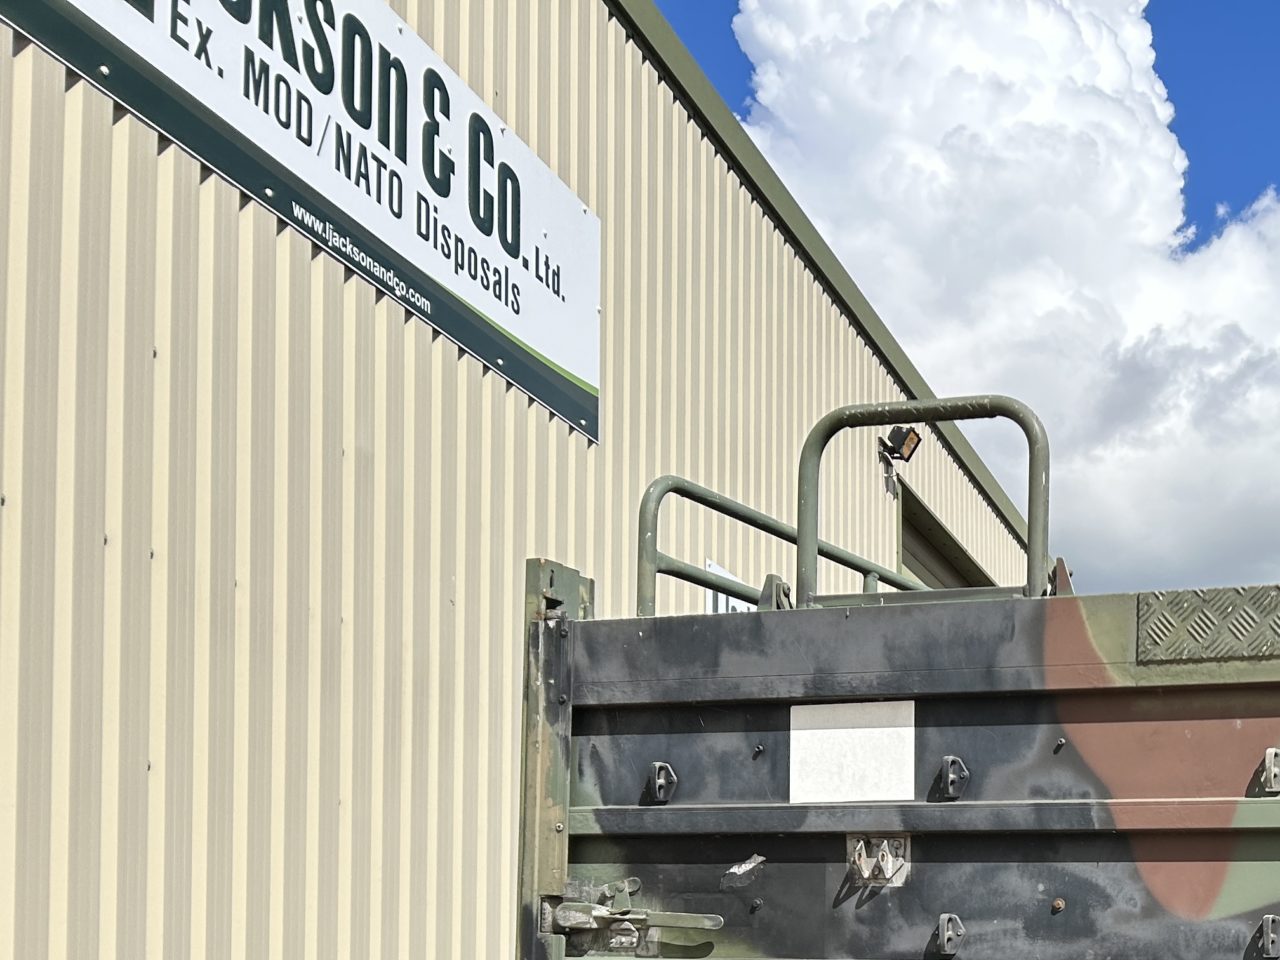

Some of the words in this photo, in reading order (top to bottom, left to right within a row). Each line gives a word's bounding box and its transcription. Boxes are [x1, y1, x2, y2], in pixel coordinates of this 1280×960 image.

[170, 0, 223, 79] EX.
[416, 191, 520, 315] Disposals
[291, 200, 431, 314] www.ljacksonandco.com
[422, 68, 455, 198] &
[535, 246, 566, 302] Ltd.
